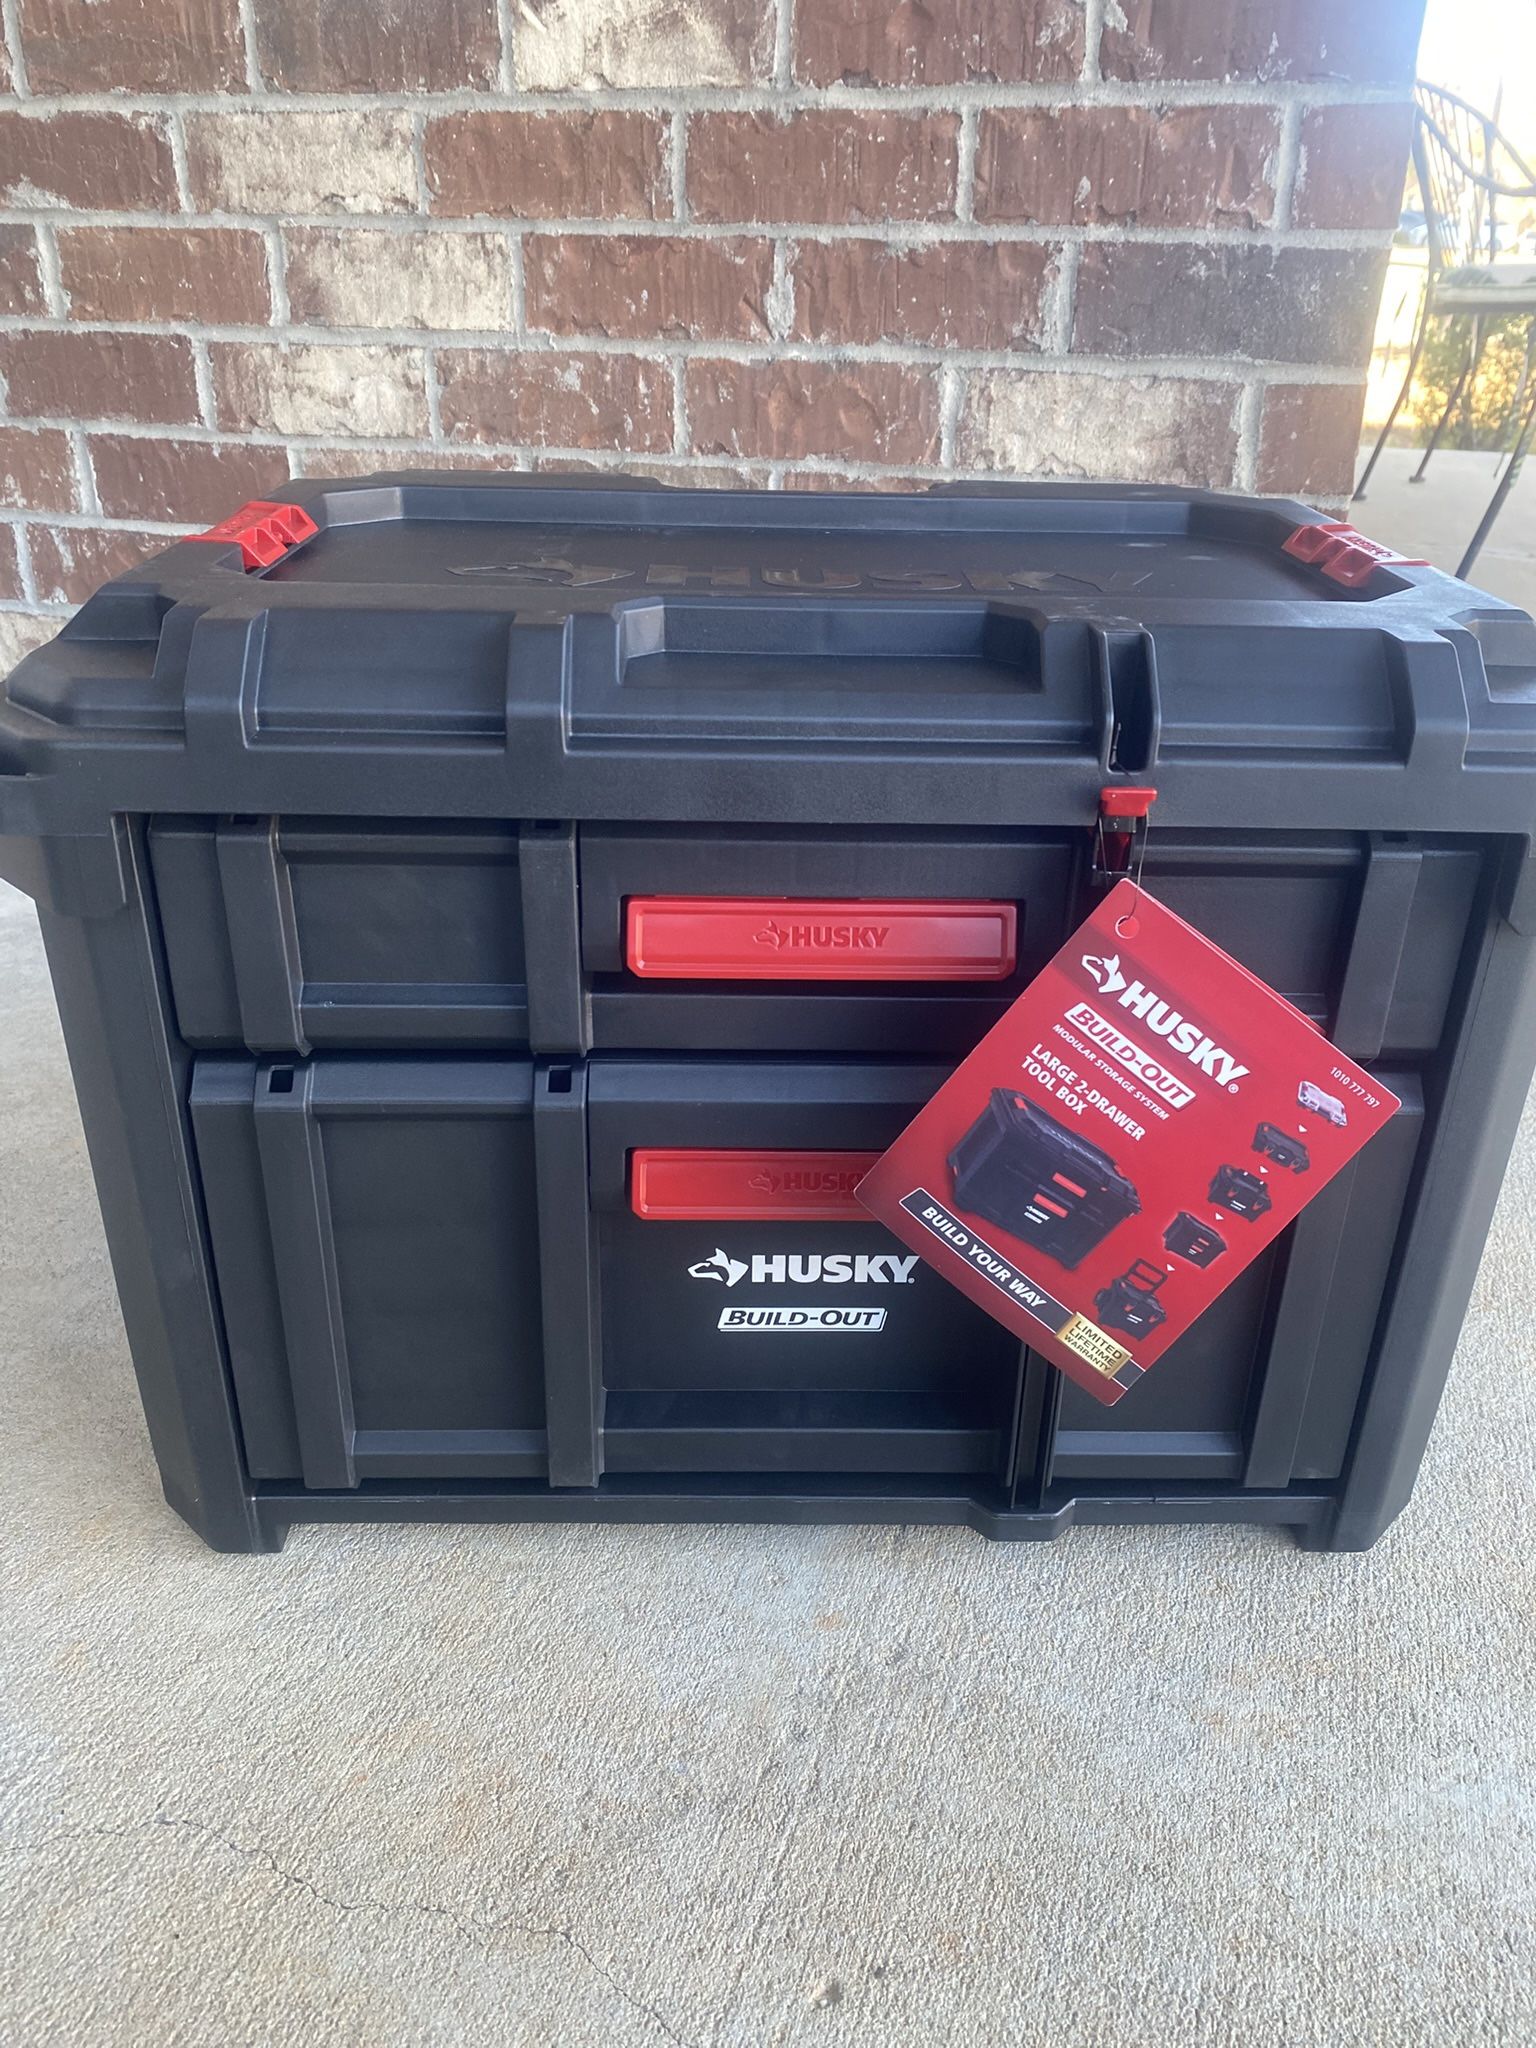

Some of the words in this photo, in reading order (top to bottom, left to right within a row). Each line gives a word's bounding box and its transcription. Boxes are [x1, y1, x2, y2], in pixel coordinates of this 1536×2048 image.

[645, 562, 1154, 592] HUSKY
[789, 926, 890, 947] HUSKY
[1052, 1024, 1095, 1061] MODULAR
[1094, 1058, 1135, 1094] STORAGE
[1133, 1089, 1170, 1120] SYSTEM
[1070, 1008, 1190, 1101] BUILD-OUT
[1021, 1056, 1057, 1091] TOOL
[1055, 1083, 1088, 1115] BOX
[1031, 1043, 1078, 1085] LARGE
[1078, 1079, 1146, 1141] 2-DRAWER
[1330, 1066, 1350, 1085] 1010
[1348, 1081, 1366, 1096] 777
[1363, 1093, 1380, 1108] 797
[782, 1172, 864, 1193] HUSK
[921, 1206, 968, 1246] BUILD
[967, 1244, 1011, 1282] YOUR
[1008, 1278, 1047, 1307] WAY
[724, 1309, 880, 1326] BUILD-OUT
[1064, 1334, 1111, 1372] WARRANTY
[1068, 1327, 1117, 1367] LIFETIME
[1074, 1320, 1123, 1360] LIMITED
